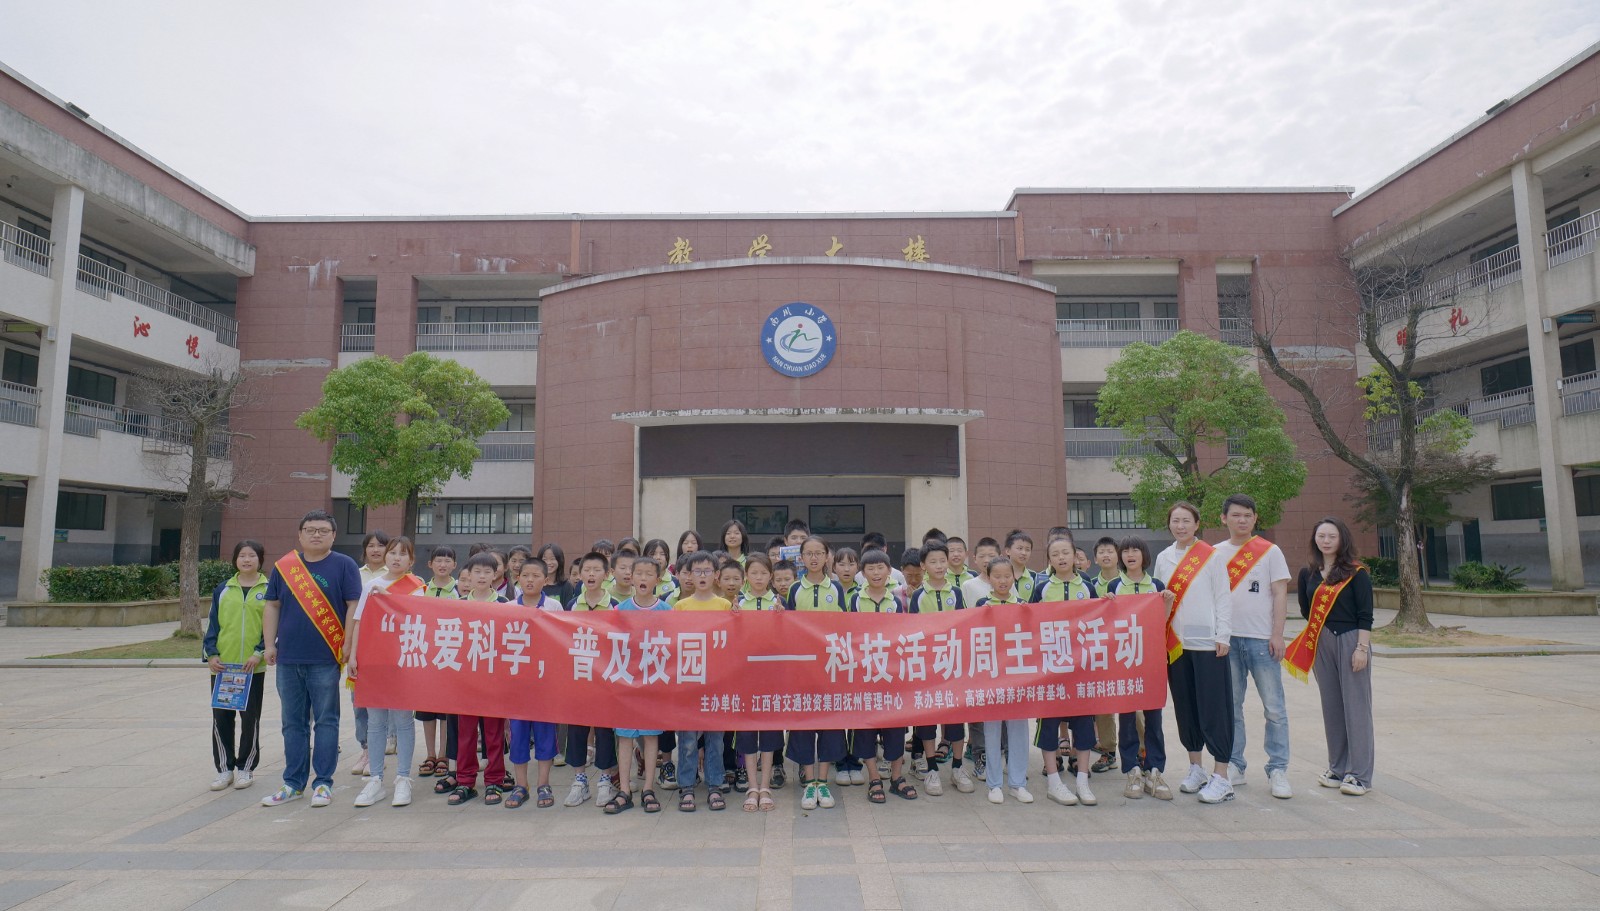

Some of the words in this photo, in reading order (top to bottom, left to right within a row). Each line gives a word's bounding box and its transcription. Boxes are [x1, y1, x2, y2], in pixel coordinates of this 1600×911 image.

[667, 234, 931, 264] 教学大楼
[770, 306, 828, 327] 南川小学
[771, 355, 784, 367] NAN
[783, 363, 803, 372] CHUAN
[803, 361, 817, 372] XIAO
[817, 353, 827, 365] XUE
[1230, 552, 1254, 583] 南新科
[1305, 584, 1337, 650] 科普基地欢迎您
